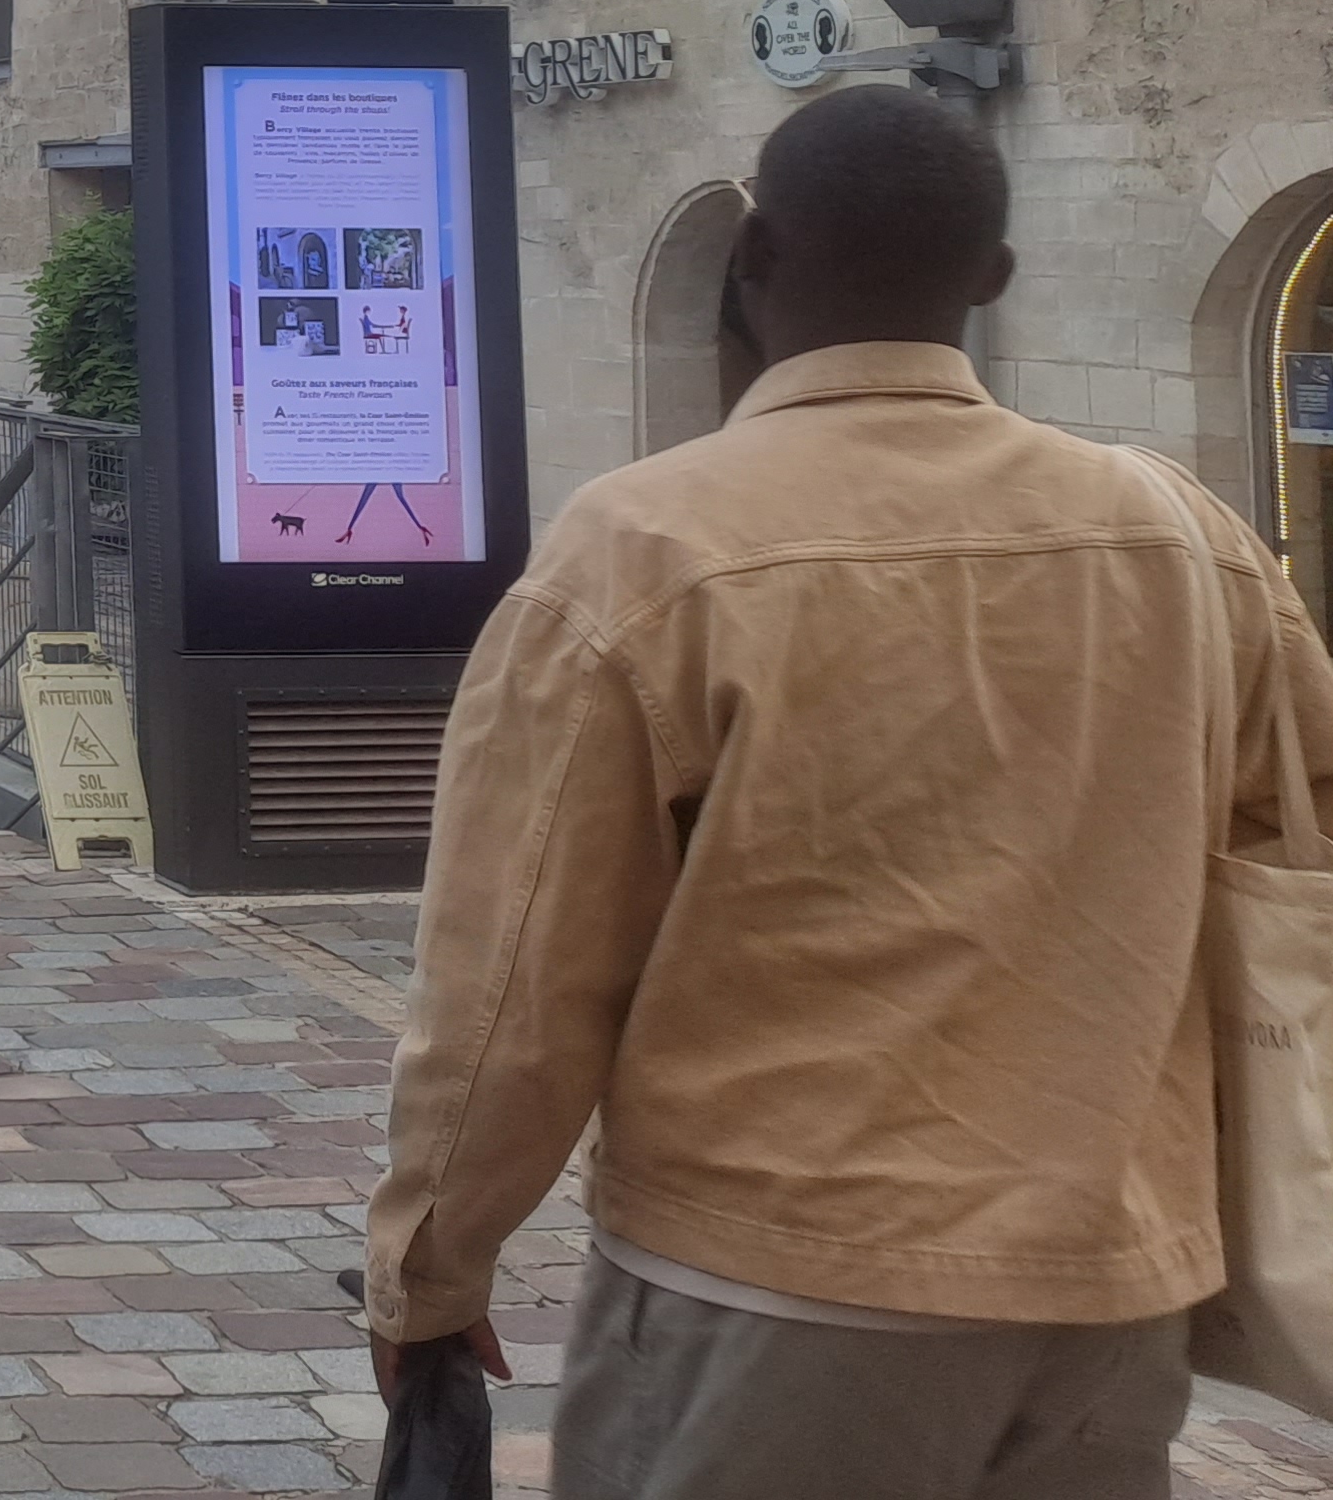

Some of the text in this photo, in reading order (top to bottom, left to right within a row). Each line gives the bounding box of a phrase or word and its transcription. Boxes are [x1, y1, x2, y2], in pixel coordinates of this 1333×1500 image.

[523, 30, 659, 105] GRENE
[306, 92, 329, 101] dans
[348, 93, 397, 102] boutiques
[330, 380, 366, 388] saveurs
[369, 379, 418, 389] françaises
[324, 391, 354, 399] French
[328, 574, 404, 586] Clear Channel
[39, 690, 113, 706] ATTENTION
[78, 774, 107, 790] SOL
